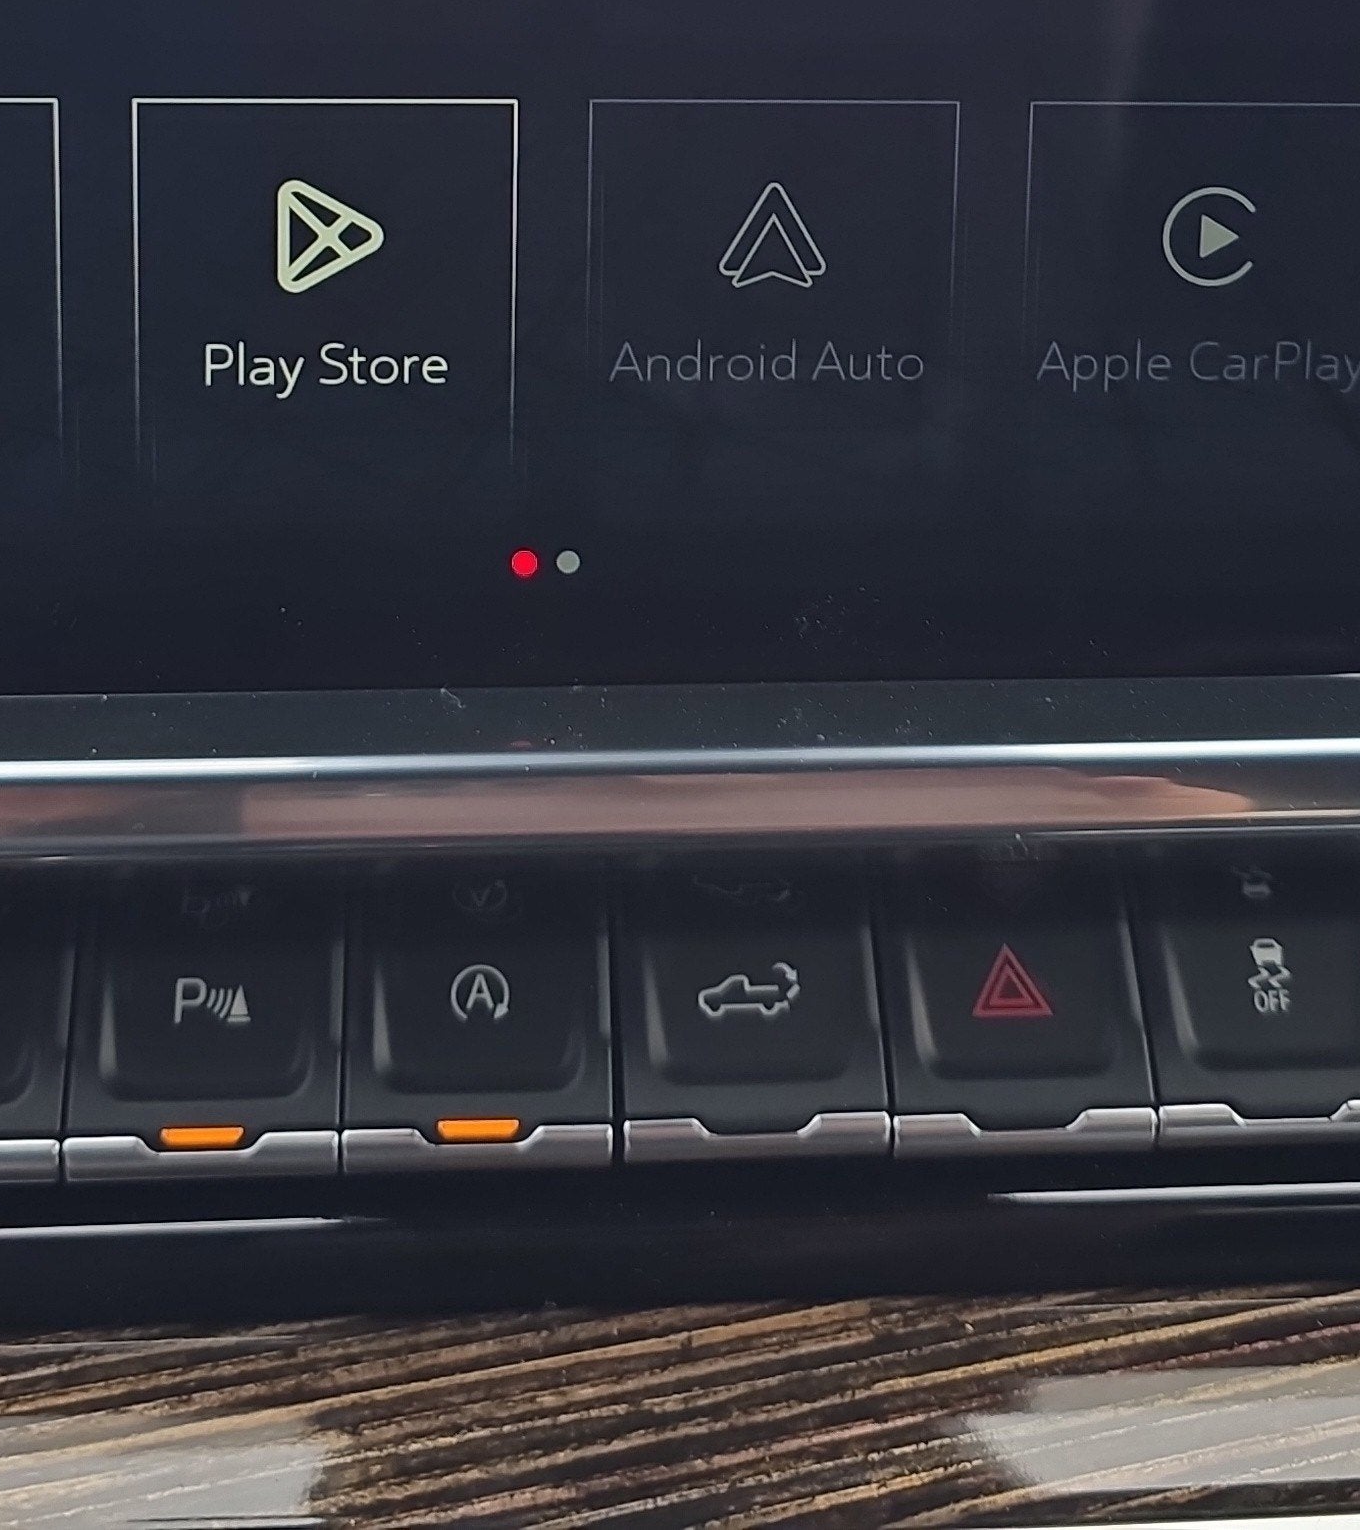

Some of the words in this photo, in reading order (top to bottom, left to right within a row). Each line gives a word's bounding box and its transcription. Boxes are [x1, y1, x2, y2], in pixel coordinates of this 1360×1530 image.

[205, 340, 305, 399] Play
[319, 342, 449, 385] Store
[609, 338, 797, 382] Android
[811, 340, 924, 381] Auto
[1036, 338, 1172, 393] Apple
[174, 977, 207, 1023] P
[1253, 989, 1291, 1013] OFF
